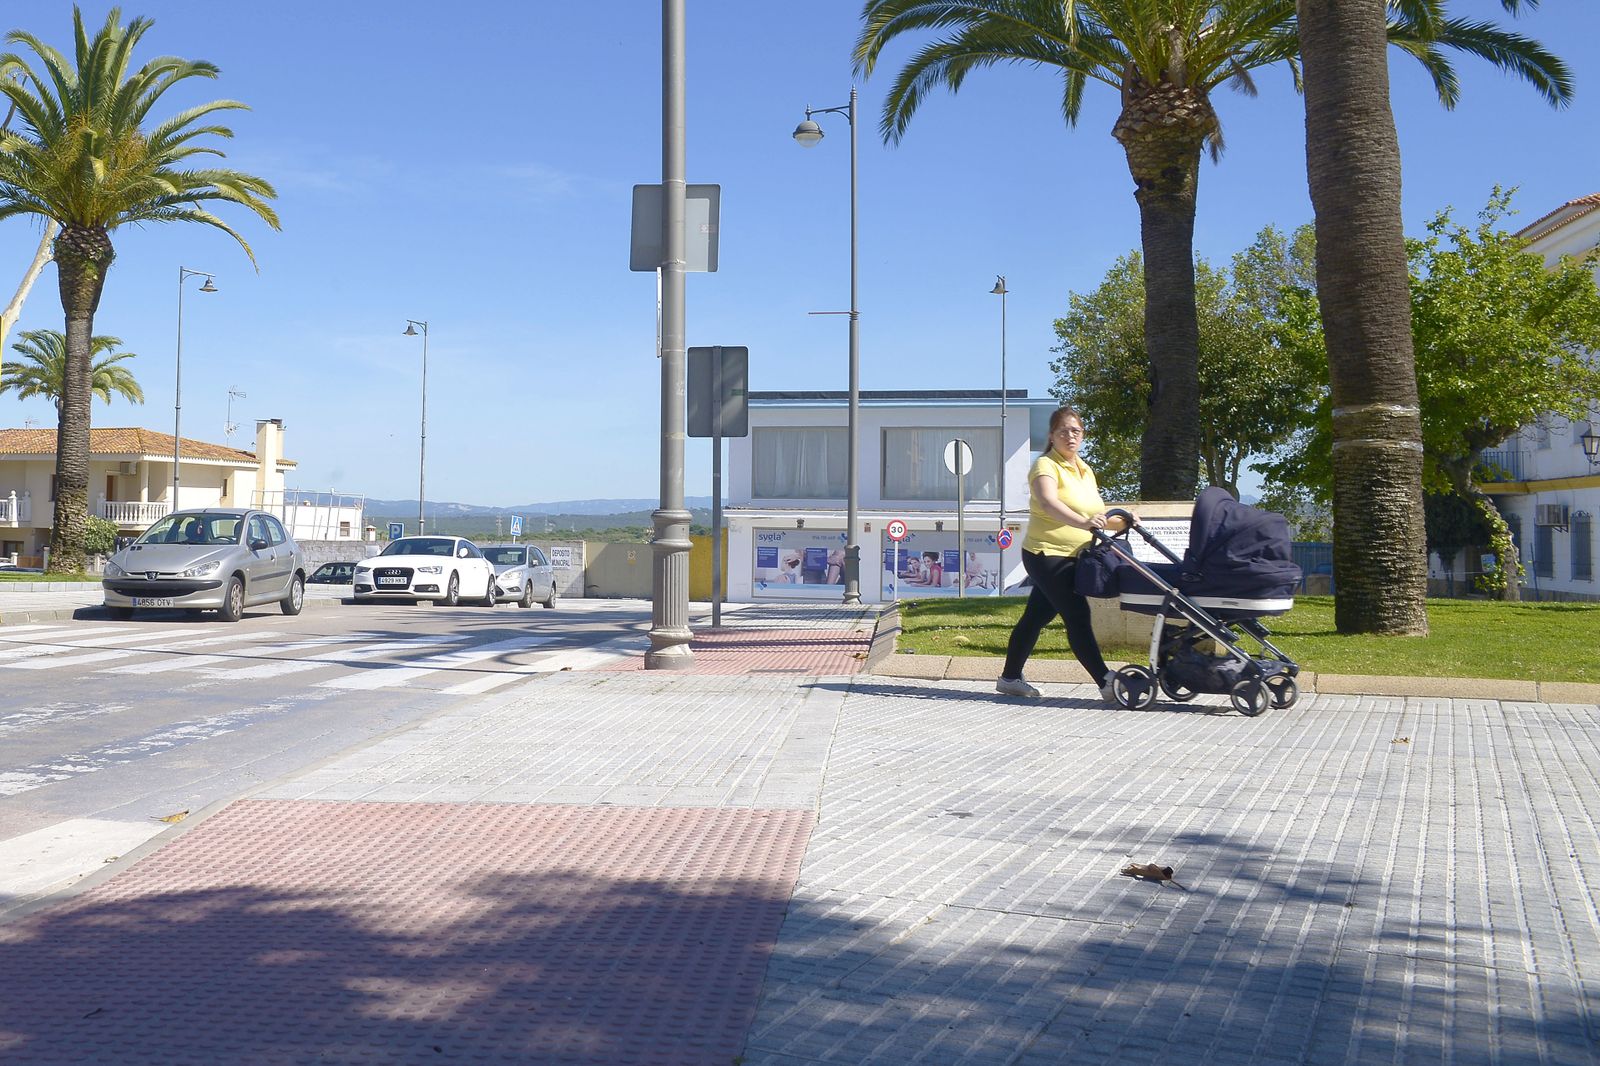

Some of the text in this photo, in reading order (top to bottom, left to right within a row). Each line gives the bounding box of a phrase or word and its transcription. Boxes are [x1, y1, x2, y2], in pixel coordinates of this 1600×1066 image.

[391, 525, 400, 538] P
[891, 526, 903, 534] 30
[758, 532, 781, 543] sygla
[552, 559, 570, 567] MUNICIPAL
